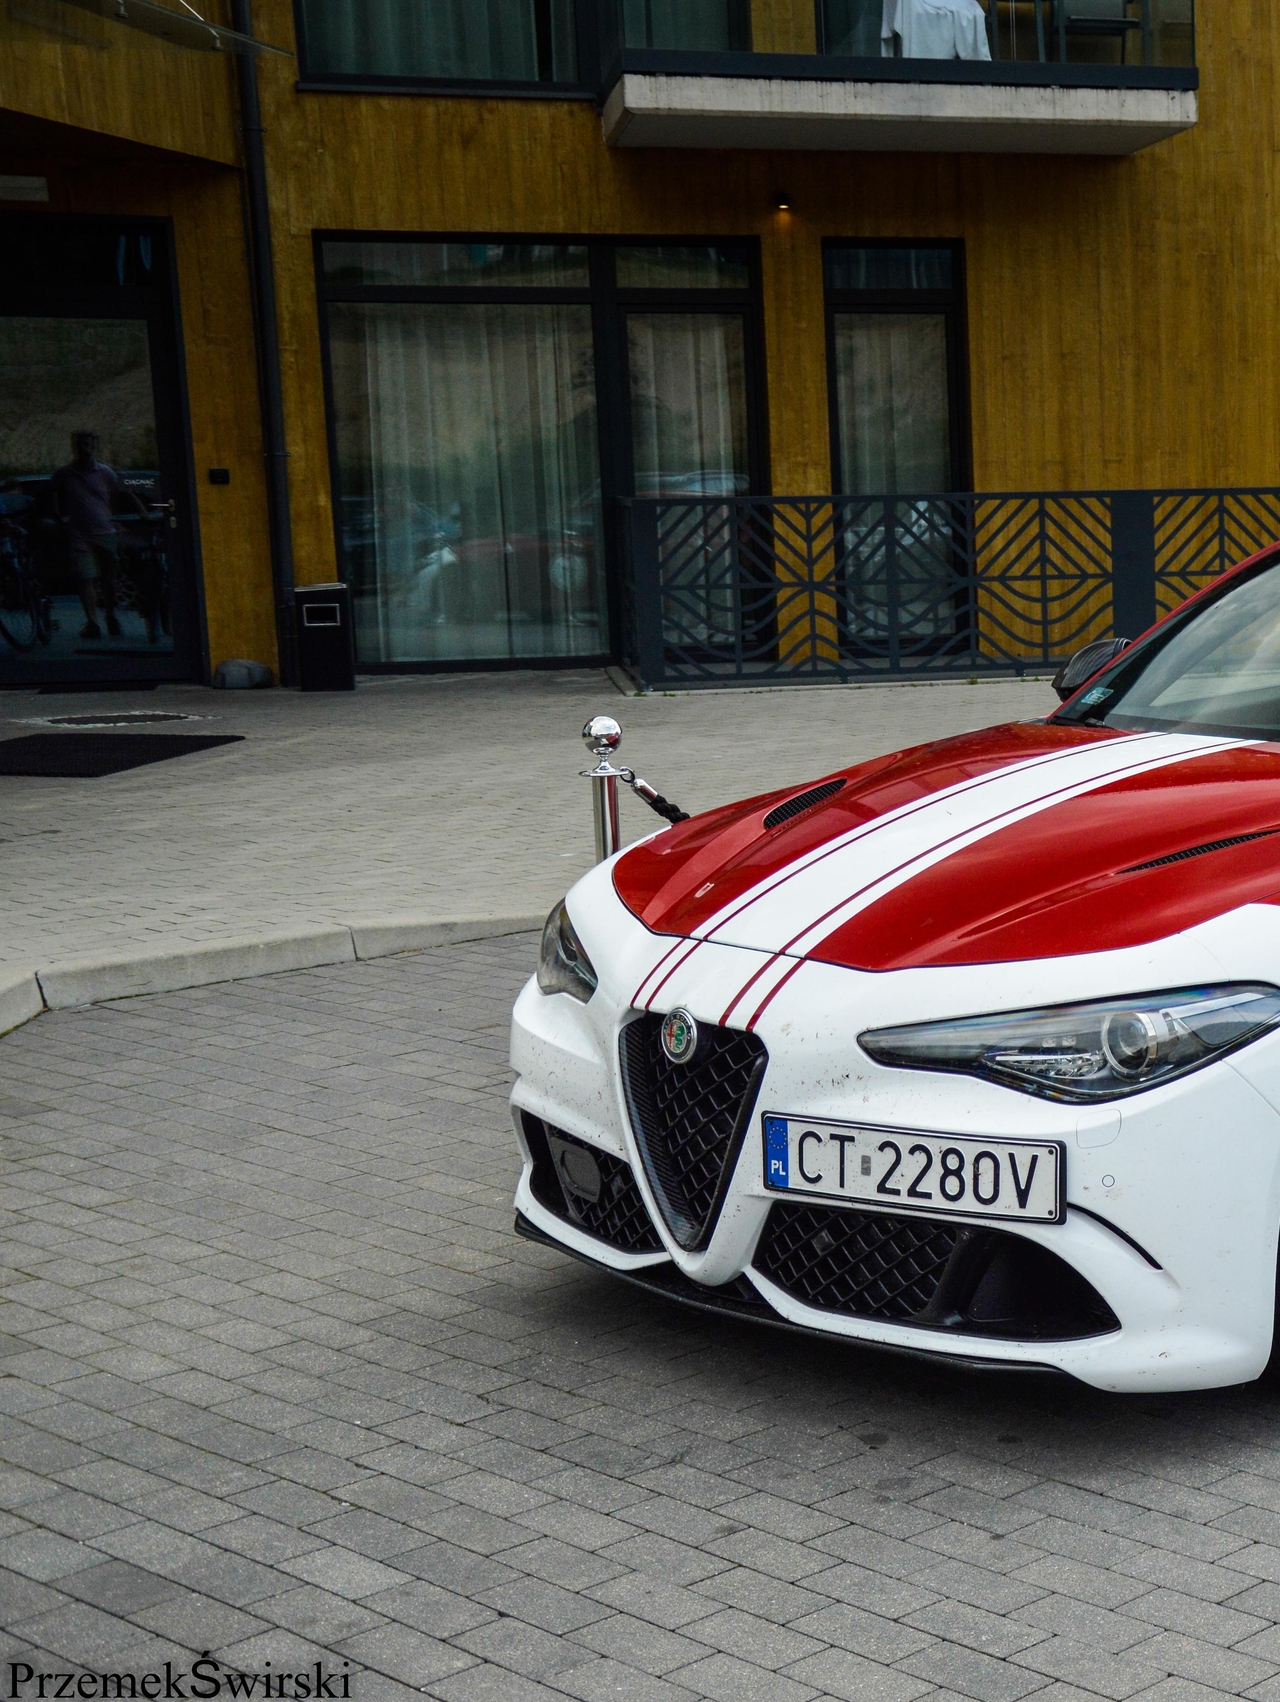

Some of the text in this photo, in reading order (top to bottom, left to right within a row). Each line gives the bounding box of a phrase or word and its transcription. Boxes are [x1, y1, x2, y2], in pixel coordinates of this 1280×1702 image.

[770, 1159, 787, 1176] PL
[798, 1130, 1040, 1210] CT 2280V
